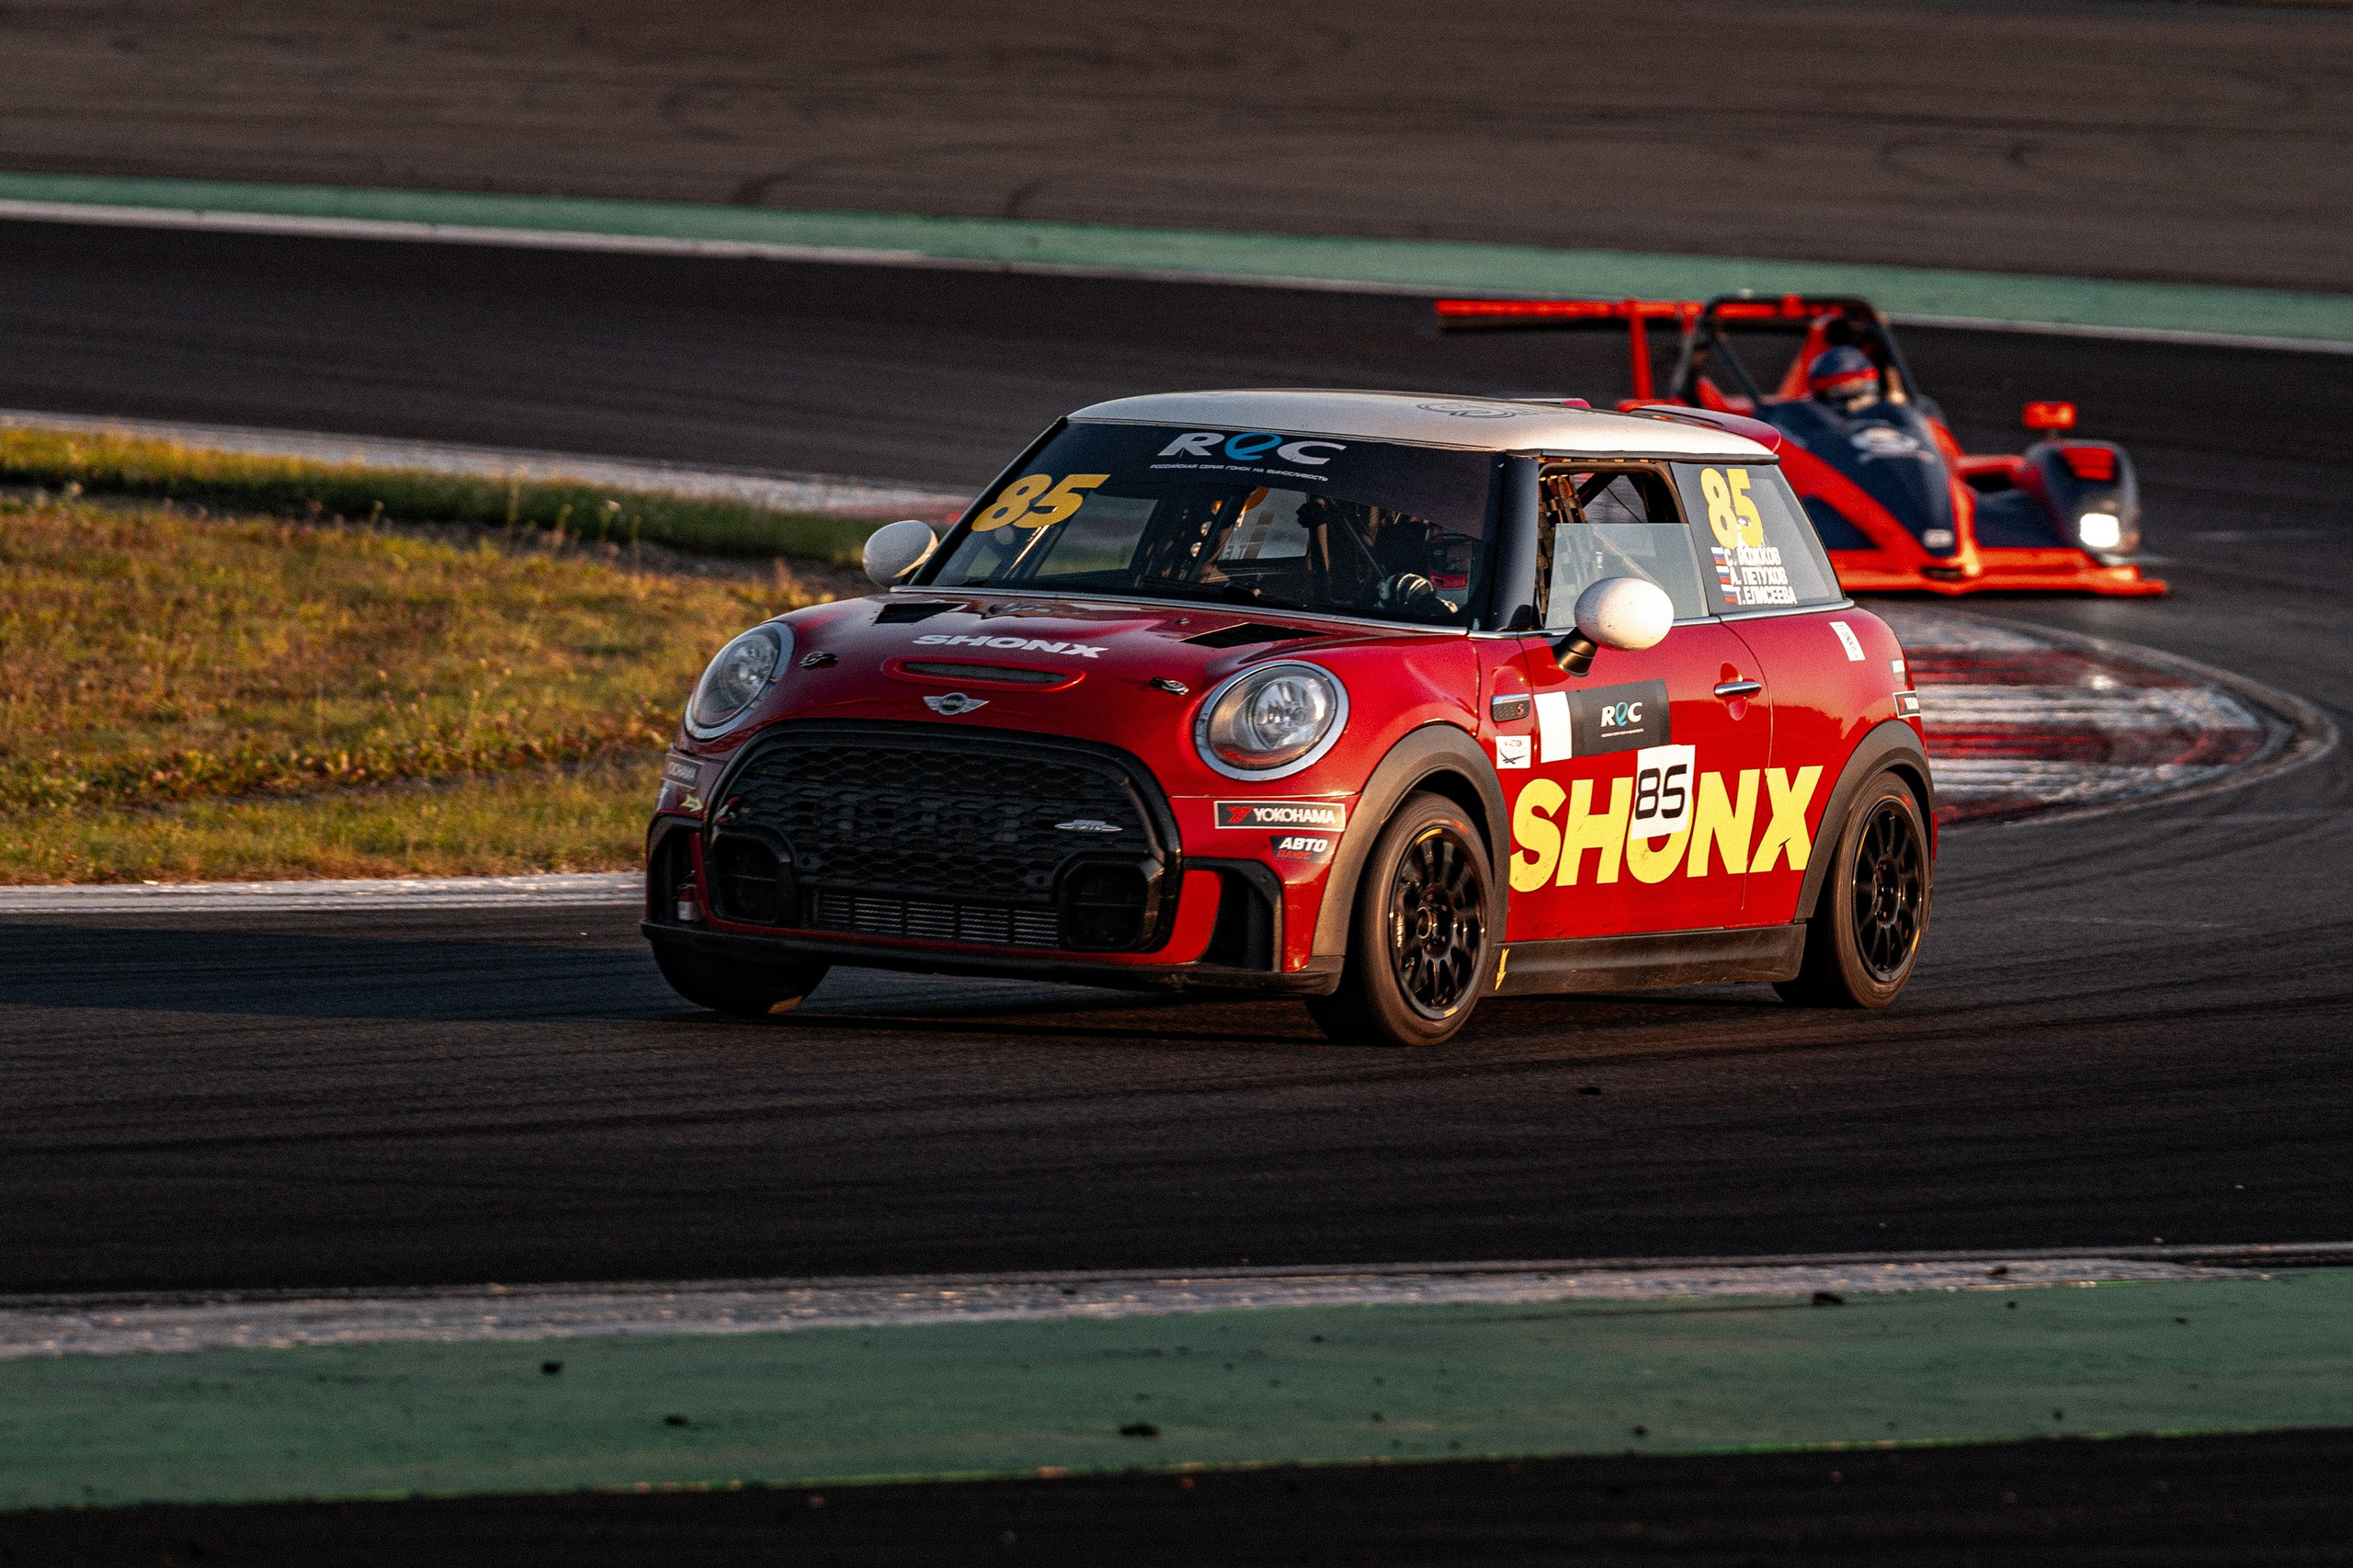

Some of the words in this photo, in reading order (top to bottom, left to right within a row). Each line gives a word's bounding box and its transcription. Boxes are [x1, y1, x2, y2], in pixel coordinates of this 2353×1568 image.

[971, 473, 1111, 532] 85
[1700, 467, 1764, 550] 85
[1740, 566, 1789, 585] ПЕТУХОВ
[913, 634, 1110, 659] SHONX
[1634, 763, 1688, 821] 85
[1253, 807, 1336, 824] YOKOHAMA
[1279, 836, 1329, 853] АВТО
